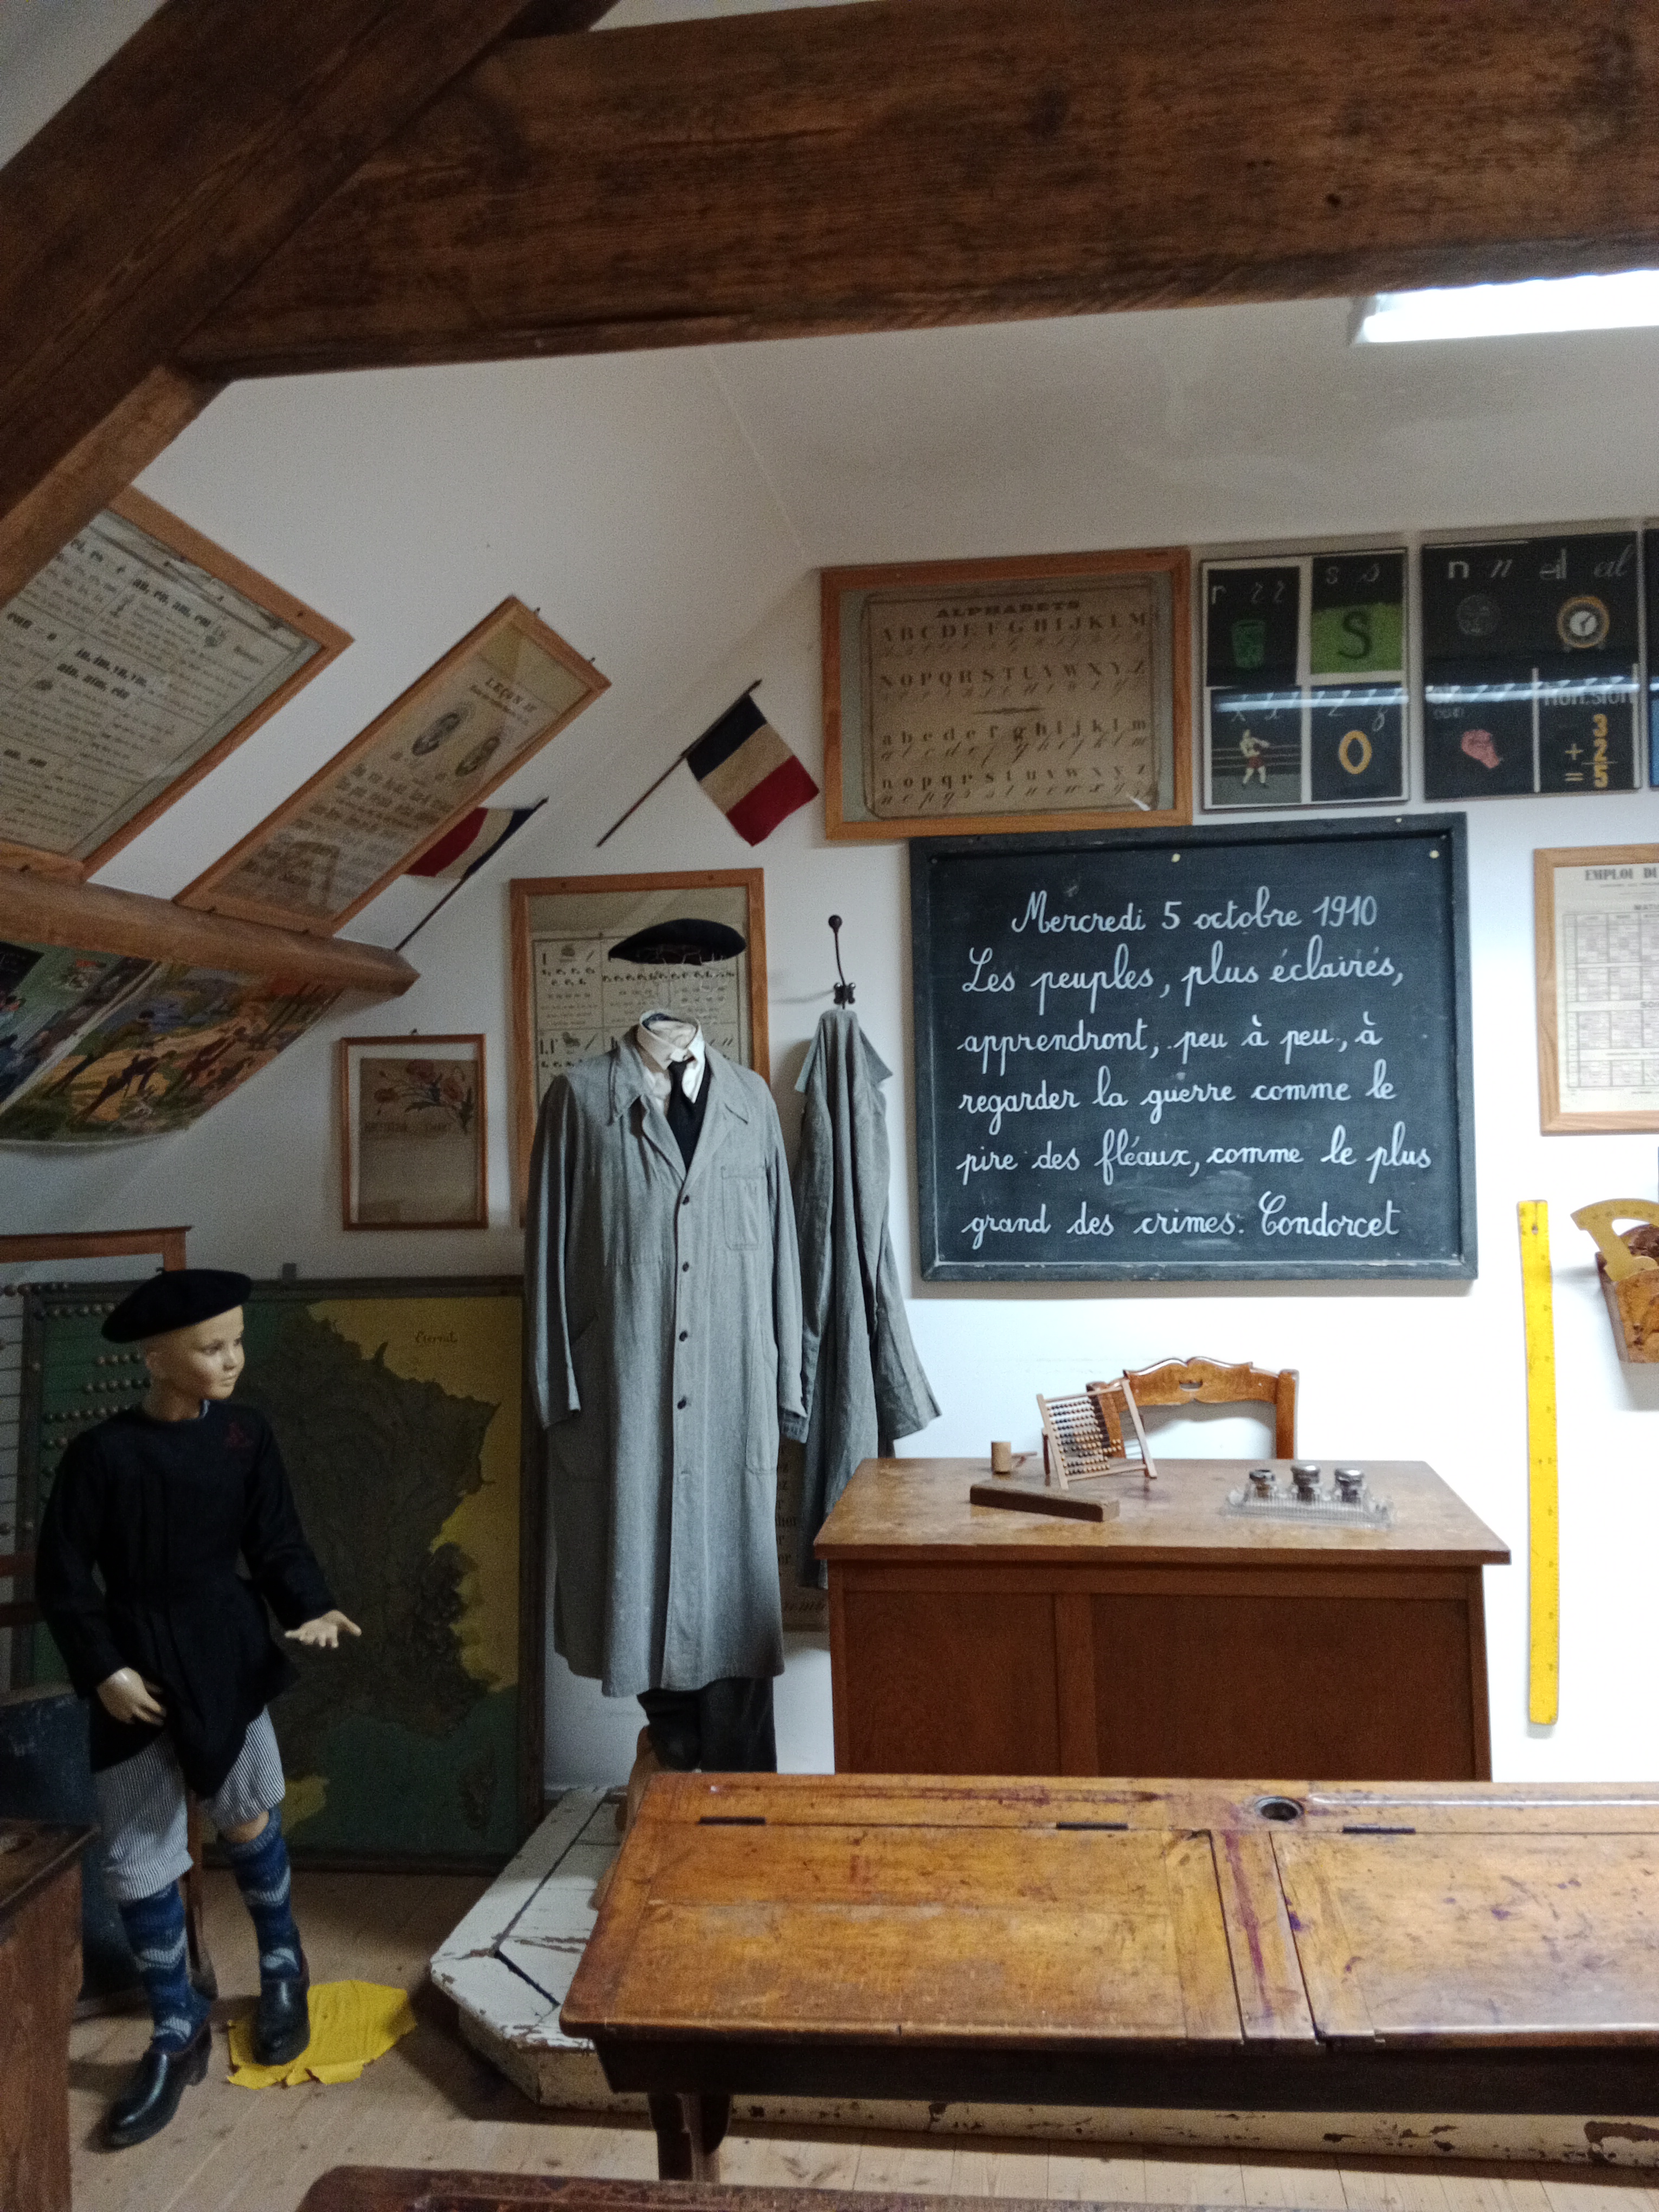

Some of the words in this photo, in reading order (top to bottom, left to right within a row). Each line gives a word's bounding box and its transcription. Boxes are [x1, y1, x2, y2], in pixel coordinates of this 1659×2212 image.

[1449, 560, 1469, 580] n
[1593, 713, 1608, 737] 3
[1594, 739, 1608, 762] 2
[1594, 762, 1609, 788] 5
[1585, 868, 1633, 880] EMPLOI
[1011, 890, 1146, 934] Mercredi
[1161, 901, 1180, 930] 5
[1193, 886, 1301, 930] octobre
[1313, 896, 1376, 927] 1910
[962, 948, 1014, 992] Les
[1181, 940, 1258, 1006] plus
[1269, 935, 1403, 986] éclairés,
[956, 1018, 1160, 1076] apprendront,
[1172, 1028, 1227, 1064] peu
[1241, 1015, 1269, 1047] à
[1354, 1012, 1382, 1047] à
[959, 1081, 1079, 1135] regarder
[1092, 1066, 1126, 1108] la
[1141, 1082, 1236, 1124] guerre
[1251, 1078, 1351, 1101] comme
[1366, 1059, 1397, 1099] le
[956, 1145, 1018, 1185] pire
[1032, 1140, 1080, 1171] des
[1095, 1129, 1200, 1185] fléaux,
[1207, 1145, 1304, 1165] comme
[1321, 1126, 1357, 1165] le
[1366, 1122, 1431, 1183] plus
[961, 1203, 1051, 1249] grand
[1067, 1202, 1114, 1236] des
[1259, 1191, 1399, 1238] Condorcet
